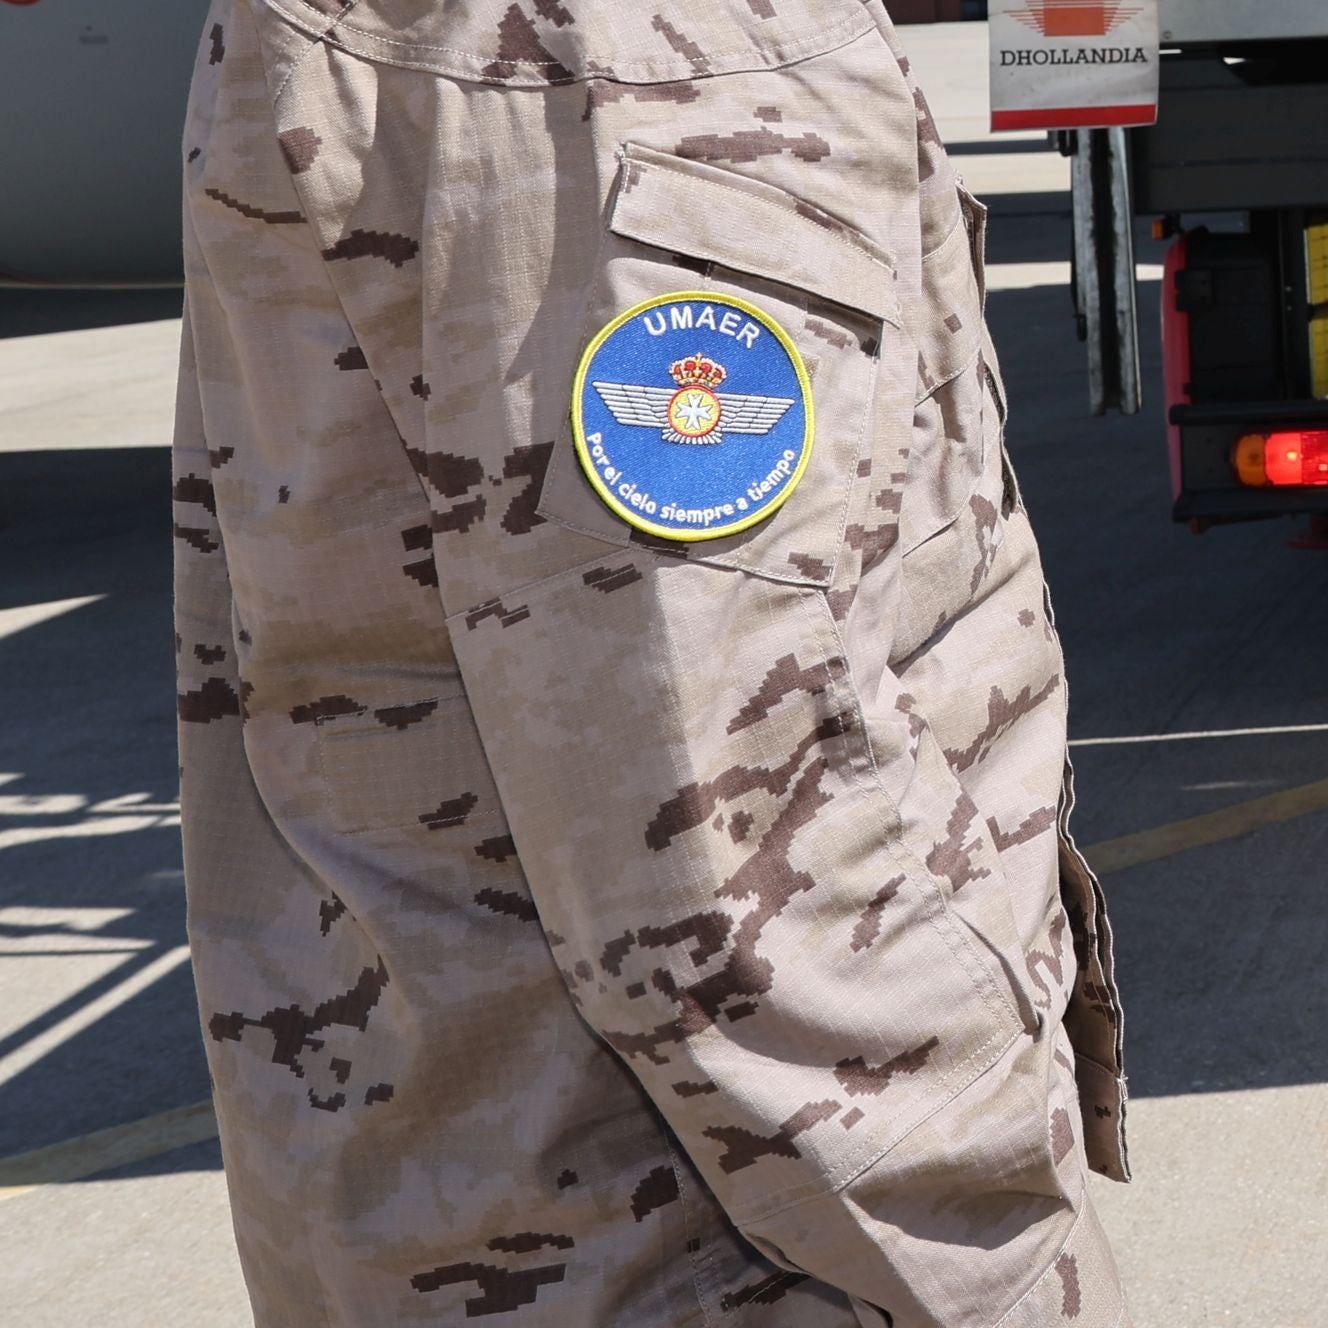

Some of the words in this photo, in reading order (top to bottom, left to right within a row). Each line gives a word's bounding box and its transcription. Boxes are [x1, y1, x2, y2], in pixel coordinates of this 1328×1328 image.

[1000, 47, 1148, 67] DHOLLANDIA
[643, 305, 760, 349] UMAER
[587, 432, 610, 466] Por
[604, 466, 623, 485] el
[618, 483, 657, 514] cielo
[659, 502, 735, 526] siempre
[735, 497, 749, 511] a
[746, 449, 796, 502] tiempo
